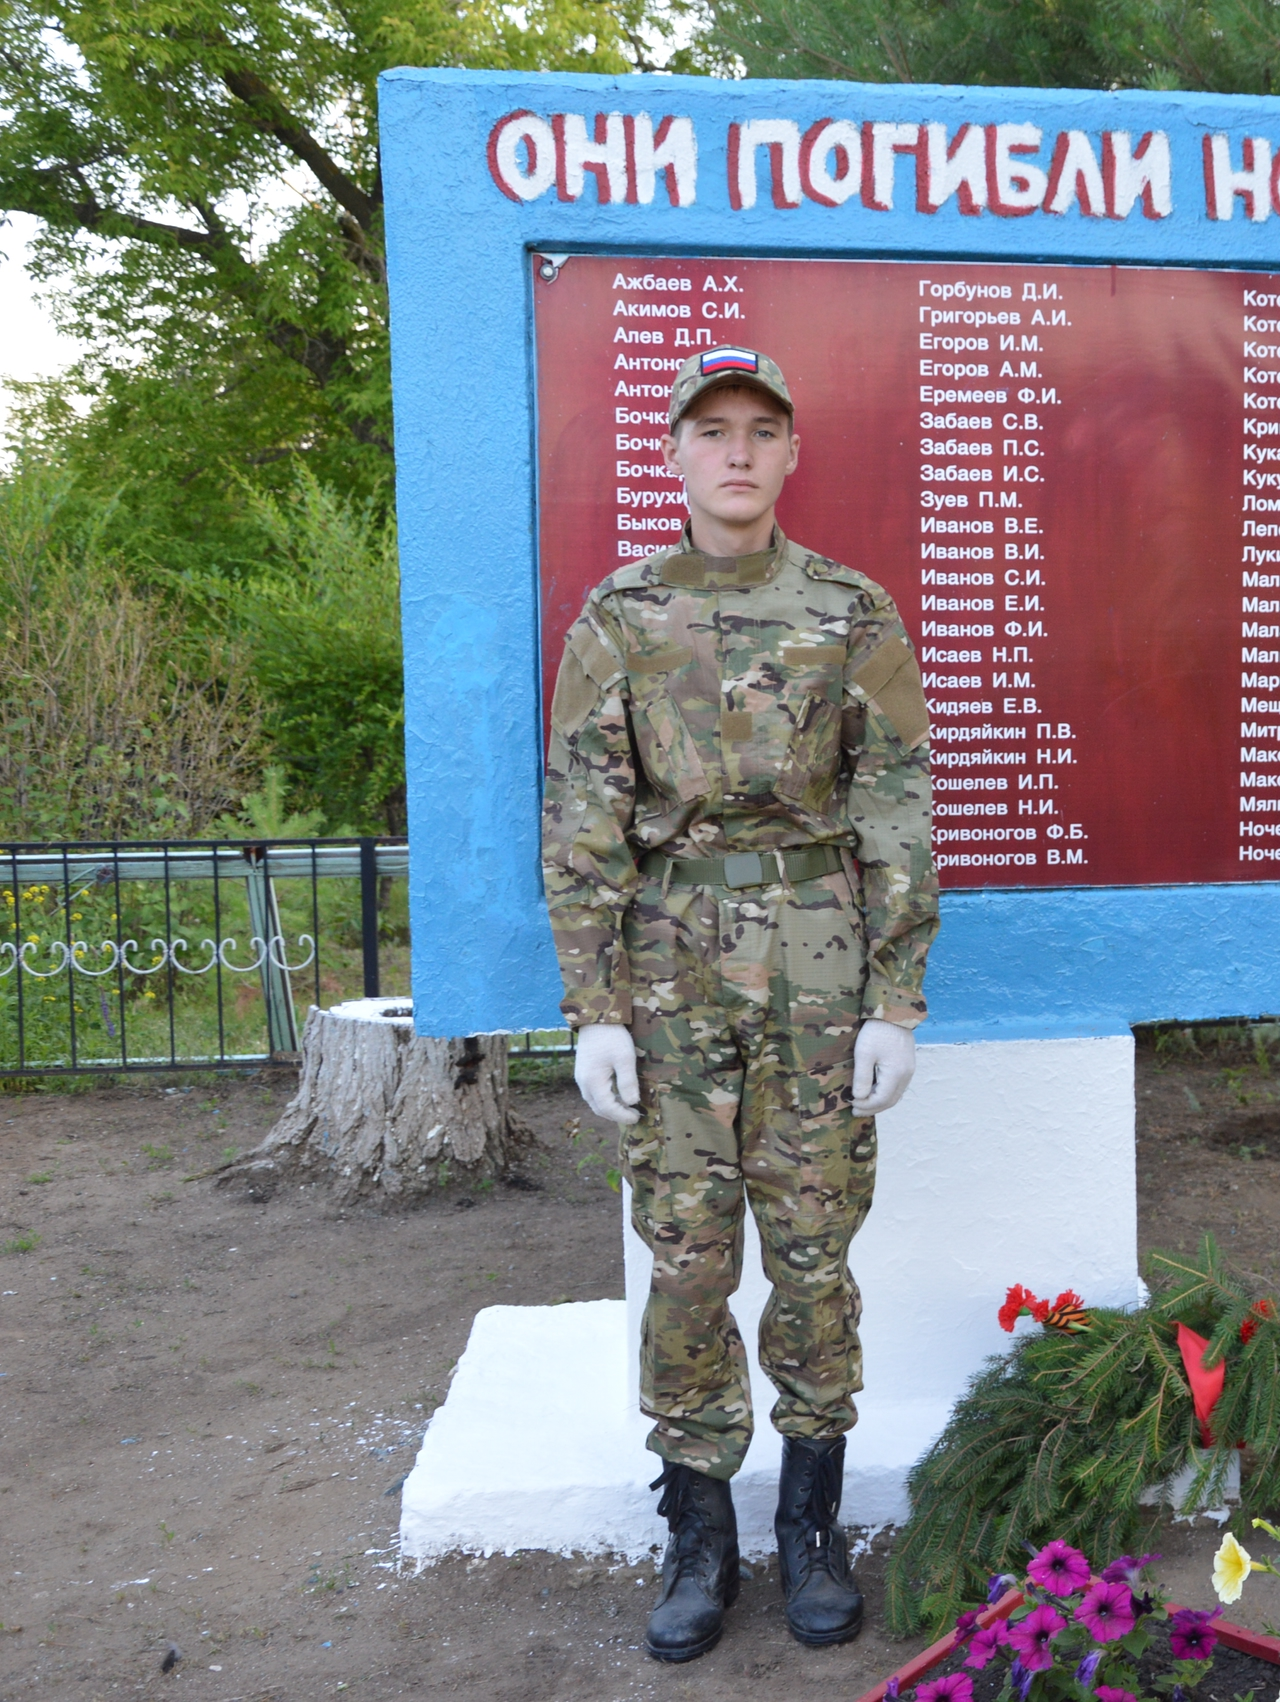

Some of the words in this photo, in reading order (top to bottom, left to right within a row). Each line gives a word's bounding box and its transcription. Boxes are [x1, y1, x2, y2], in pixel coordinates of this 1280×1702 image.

[488, 109, 697, 208] ОНИ
[727, 117, 1172, 219] ПОГИБЛИ
[612, 272, 692, 292] Ажбаев
[702, 274, 744, 293] А.Х.
[919, 279, 1012, 302] Горбунов
[1021, 282, 1063, 302] Д.И.
[613, 299, 692, 318] Акимов
[701, 301, 746, 319] С.И.
[919, 306, 1021, 328] Григорьев
[1031, 308, 1072, 326] А.И.
[613, 326, 664, 344] Алев
[674, 327, 717, 348] Д.П.
[919, 332, 989, 354] Егоров
[1000, 334, 1044, 352] И.М.
[919, 359, 989, 381] Егоров
[999, 360, 1043, 378] А.М.
[919, 385, 1008, 407] Еремеев
[1017, 387, 1062, 405] Ф.И.
[919, 411, 993, 430] Забаев
[1002, 412, 1044, 431] С.В.
[919, 437, 993, 456] Забаев
[1003, 439, 1045, 457] П.С.
[919, 463, 993, 482] Забаев
[1003, 465, 1045, 483] И.С.
[920, 490, 969, 512] Зуев
[978, 490, 1023, 508] П.М.
[617, 513, 682, 531] Быков
[920, 516, 994, 534] Иванов
[1004, 517, 1044, 534] В.Е.
[920, 542, 995, 560] Иванов
[1004, 543, 1045, 560] В.И.
[921, 568, 995, 586] Иванов
[1004, 568, 1046, 586] С.И.
[921, 594, 995, 612] Иванов
[1004, 594, 1045, 612] Е.И.
[921, 620, 995, 637] Иванов
[1004, 620, 1048, 637] Ф.И.
[922, 646, 982, 663] Исаев
[992, 646, 1034, 663] Н.П.
[922, 672, 983, 689] Исаев
[992, 671, 1036, 689] И.М.
